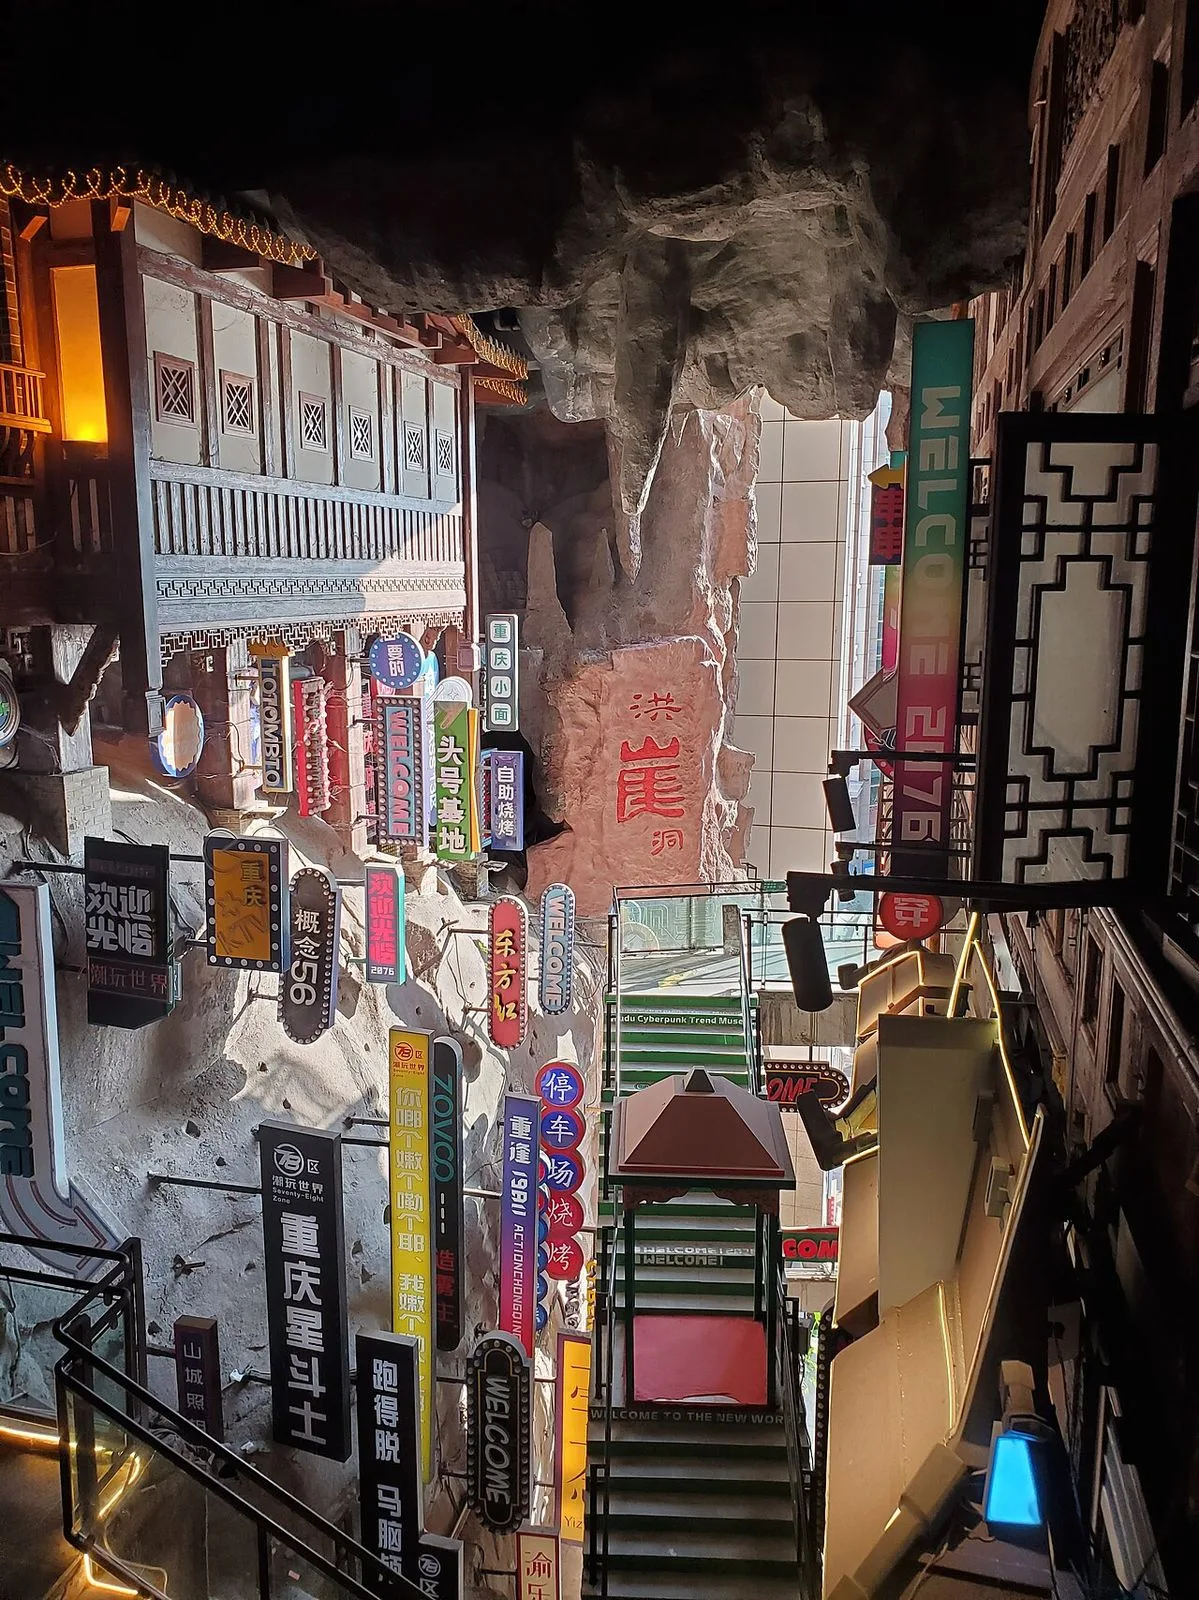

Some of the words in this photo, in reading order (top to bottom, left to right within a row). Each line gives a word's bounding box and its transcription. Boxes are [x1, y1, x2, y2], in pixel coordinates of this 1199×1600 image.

[387, 644, 405, 677] 要的
[492, 623, 510, 722] 重庆小面
[388, 710, 411, 835] WELCOME
[437, 736, 467, 854] 头号基地
[496, 766, 516, 838] 自助烧烤
[86, 881, 152, 922] 欢迎
[241, 860, 264, 907] 重庆
[86, 915, 153, 957] 光临
[369, 871, 396, 965] 欢迎光临
[546, 895, 568, 1008] WELCOME
[637, 1014, 687, 1025] Cyberpunk
[689, 1015, 717, 1025] Trend
[272, 1174, 324, 1195] 潮玩世界
[272, 1186, 324, 1203] Seventy-Eight
[272, 1195, 291, 1204] Zone
[280, 1211, 327, 1446] 重庆星斗士
[372, 1358, 401, 1465] 跑得脱
[485, 1374, 511, 1505] WELCOME
[590, 1409, 658, 1422] WLCOME
[663, 1411, 682, 1421] TO
[686, 1412, 712, 1422] THE
[716, 1413, 748, 1423] NEW
